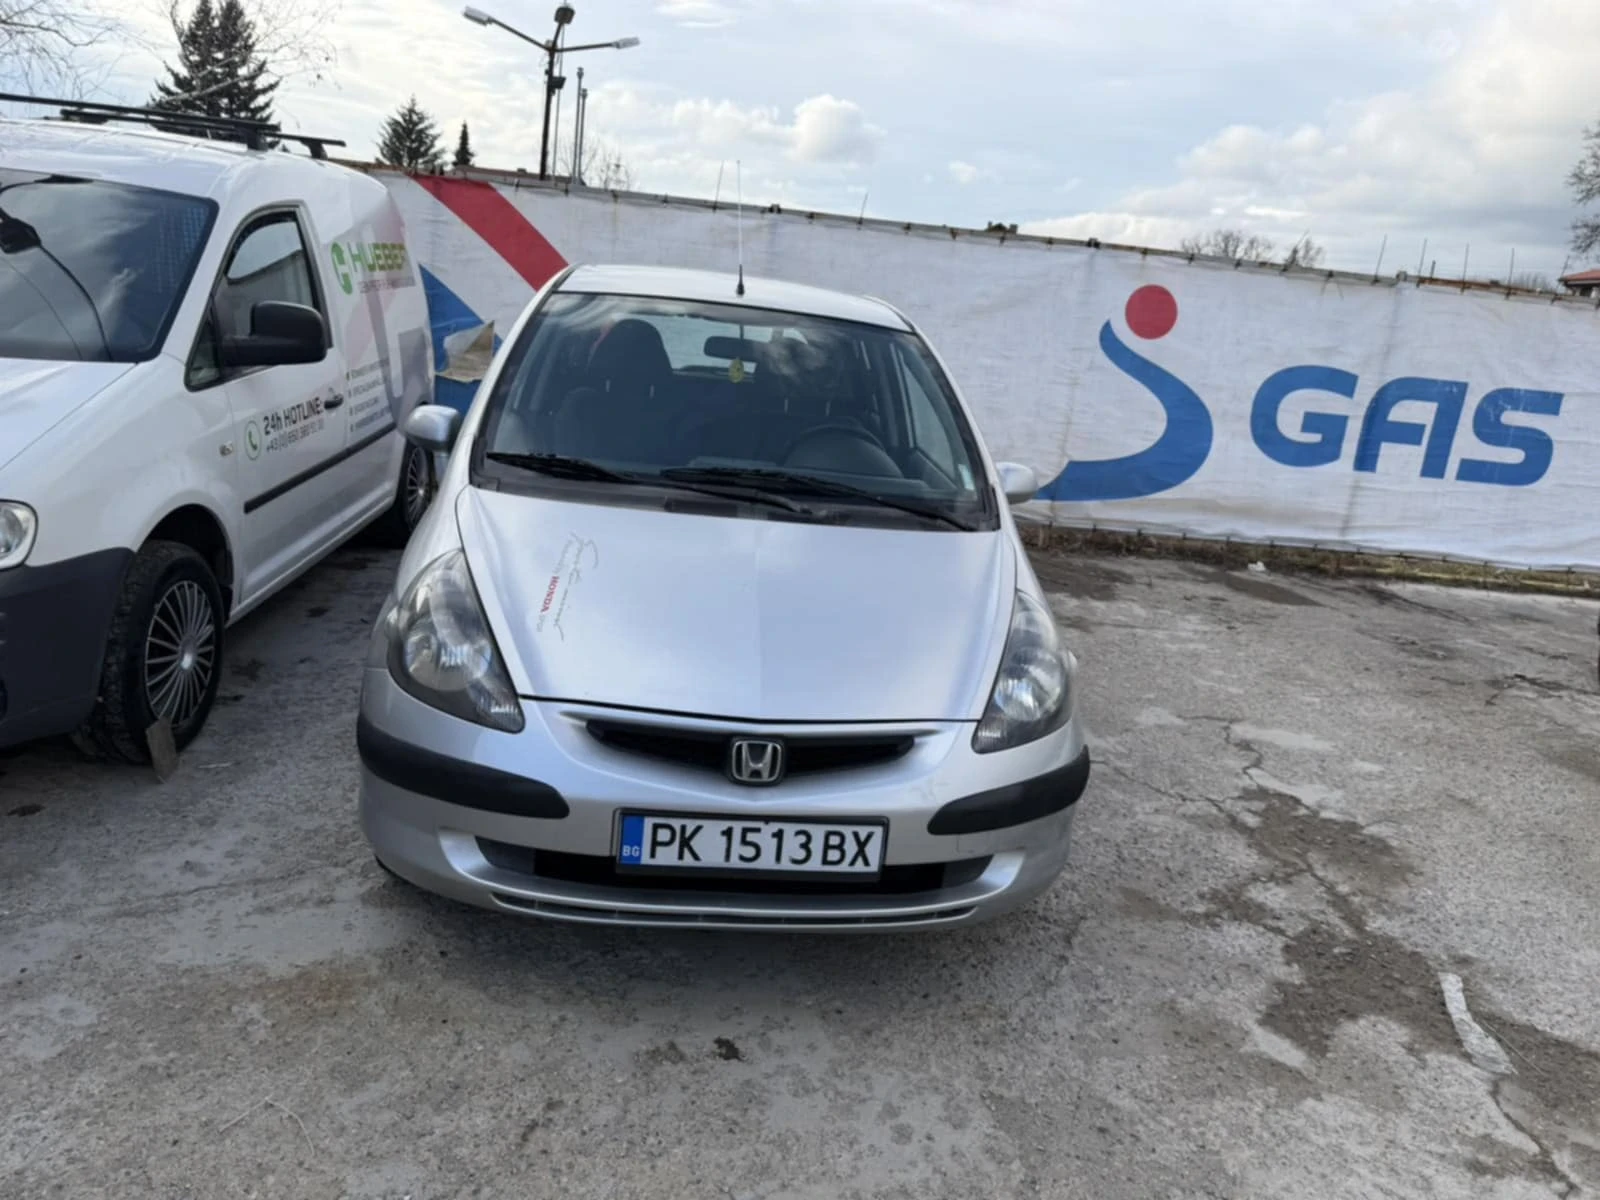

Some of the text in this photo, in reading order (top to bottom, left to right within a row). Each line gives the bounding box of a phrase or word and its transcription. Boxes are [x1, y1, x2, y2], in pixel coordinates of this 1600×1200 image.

[263, 411, 283, 436] 24h
[1250, 364, 1564, 486] GAS
[540, 575, 560, 613] HONDA
[622, 844, 641, 857] BG
[649, 822, 874, 867] PK 1513 BX
